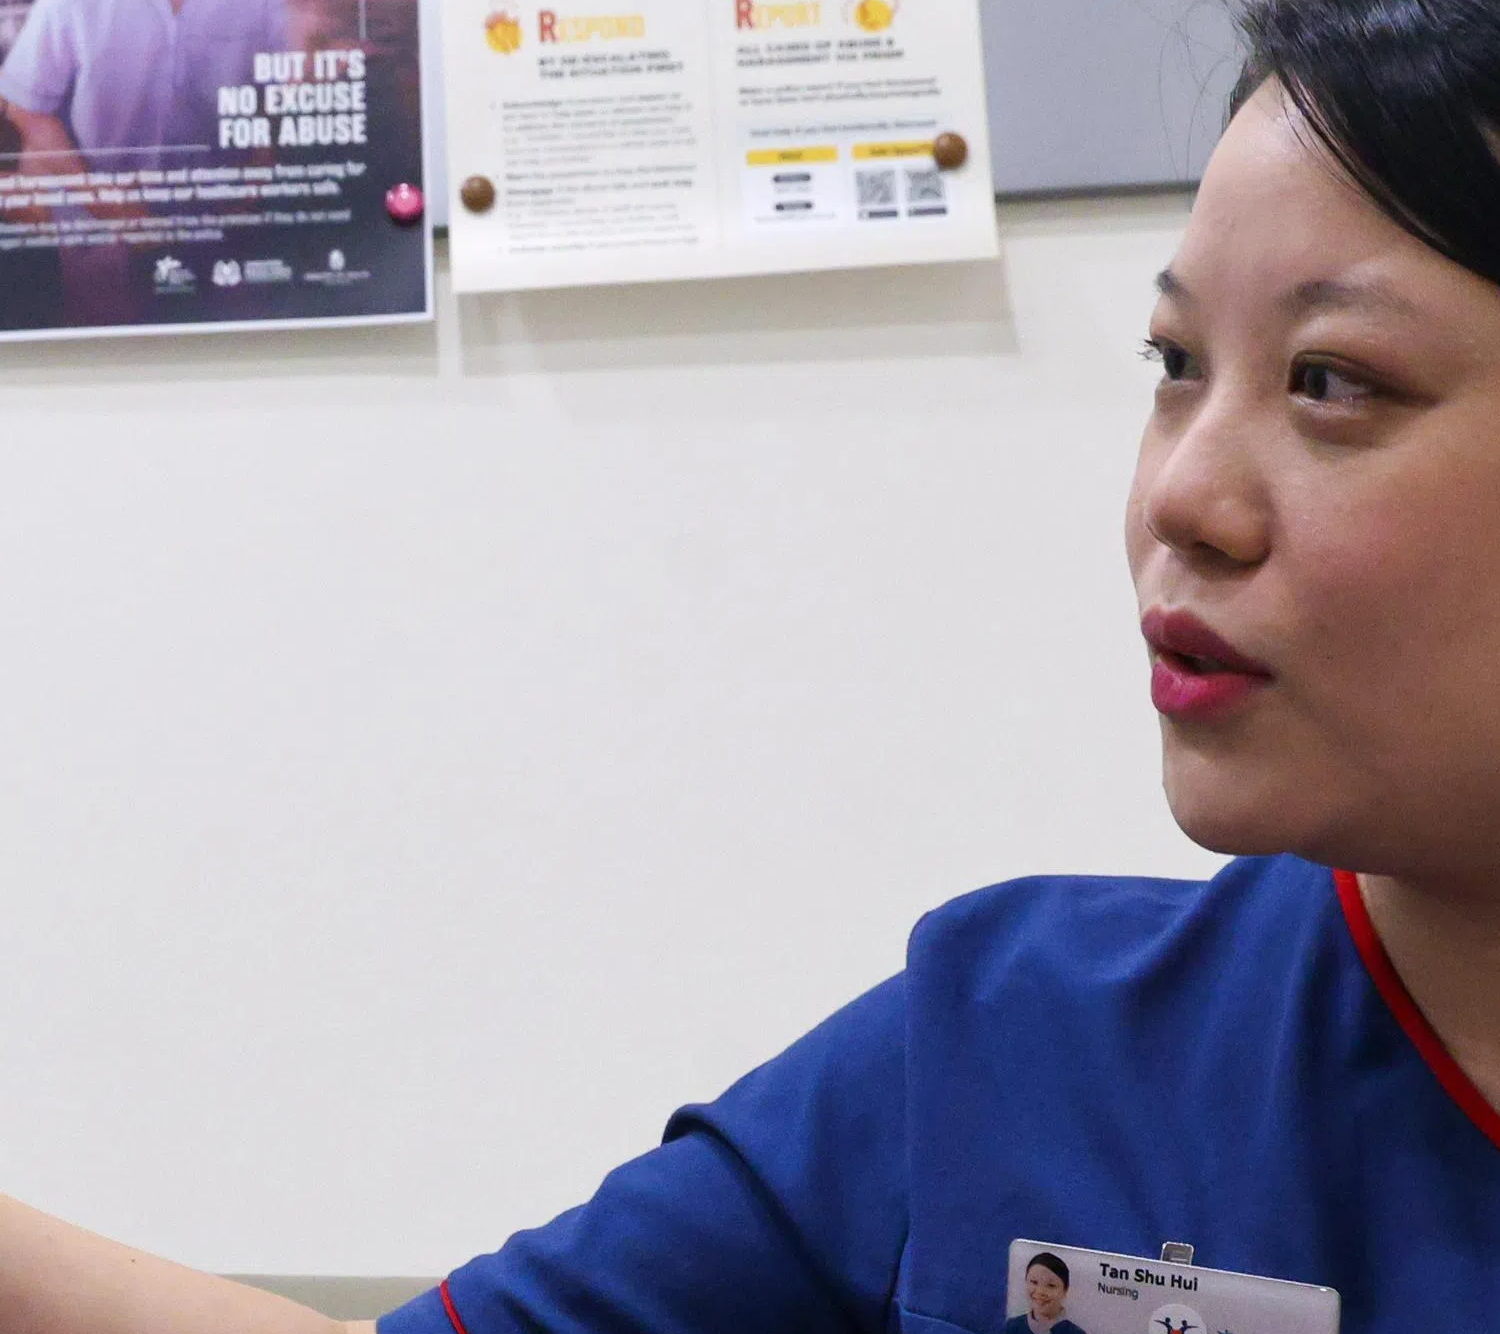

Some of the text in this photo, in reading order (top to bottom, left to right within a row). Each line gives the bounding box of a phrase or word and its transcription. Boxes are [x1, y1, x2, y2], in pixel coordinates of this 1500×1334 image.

[254, 48, 367, 83] BUT IT'S
[218, 80, 368, 117] NO EXCUSE
[219, 112, 368, 150] FOR ABUSE
[1097, 1282, 1139, 1301] Nursing
[1099, 1263, 1198, 1292] Tan Shu Hui
